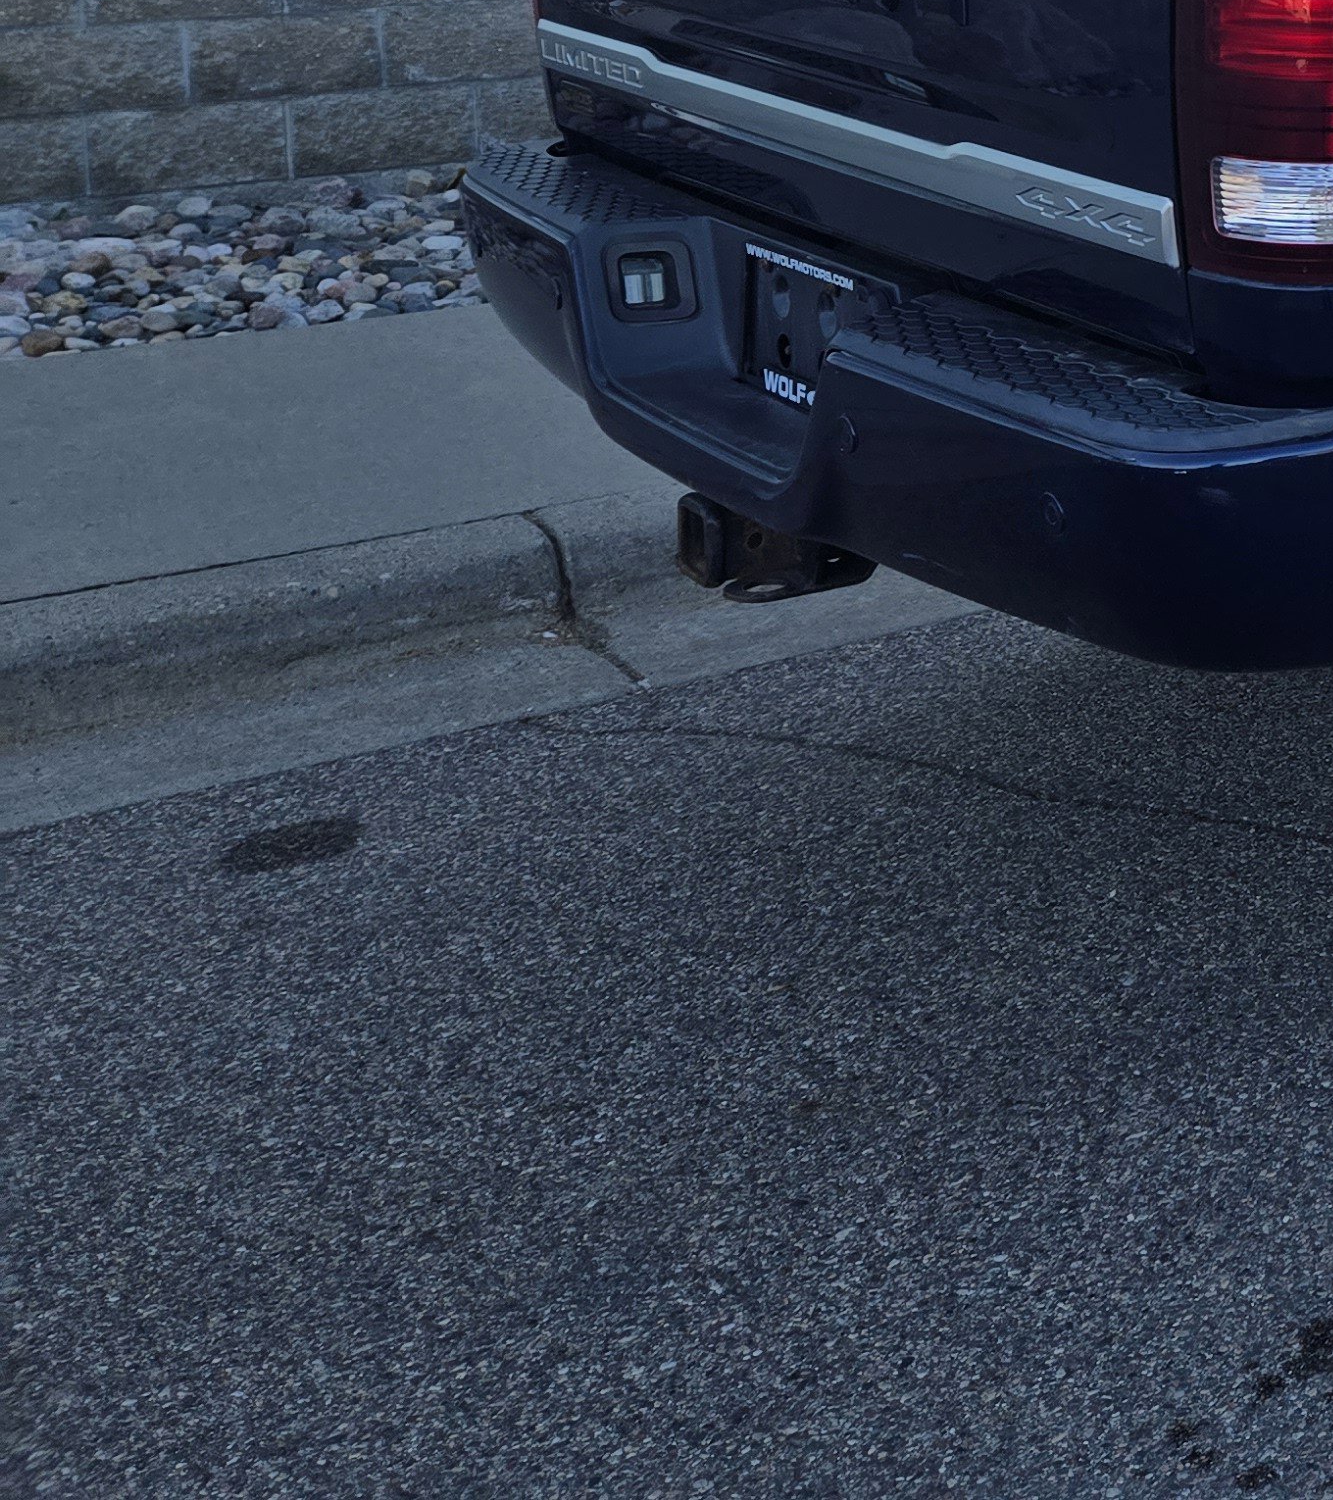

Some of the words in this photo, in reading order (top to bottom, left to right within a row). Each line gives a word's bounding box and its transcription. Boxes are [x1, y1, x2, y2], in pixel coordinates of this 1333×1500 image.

[541, 38, 644, 89] LIMITED
[745, 242, 854, 291] WWW.WOLFMOTORS.COM
[763, 368, 807, 404] WOLF
